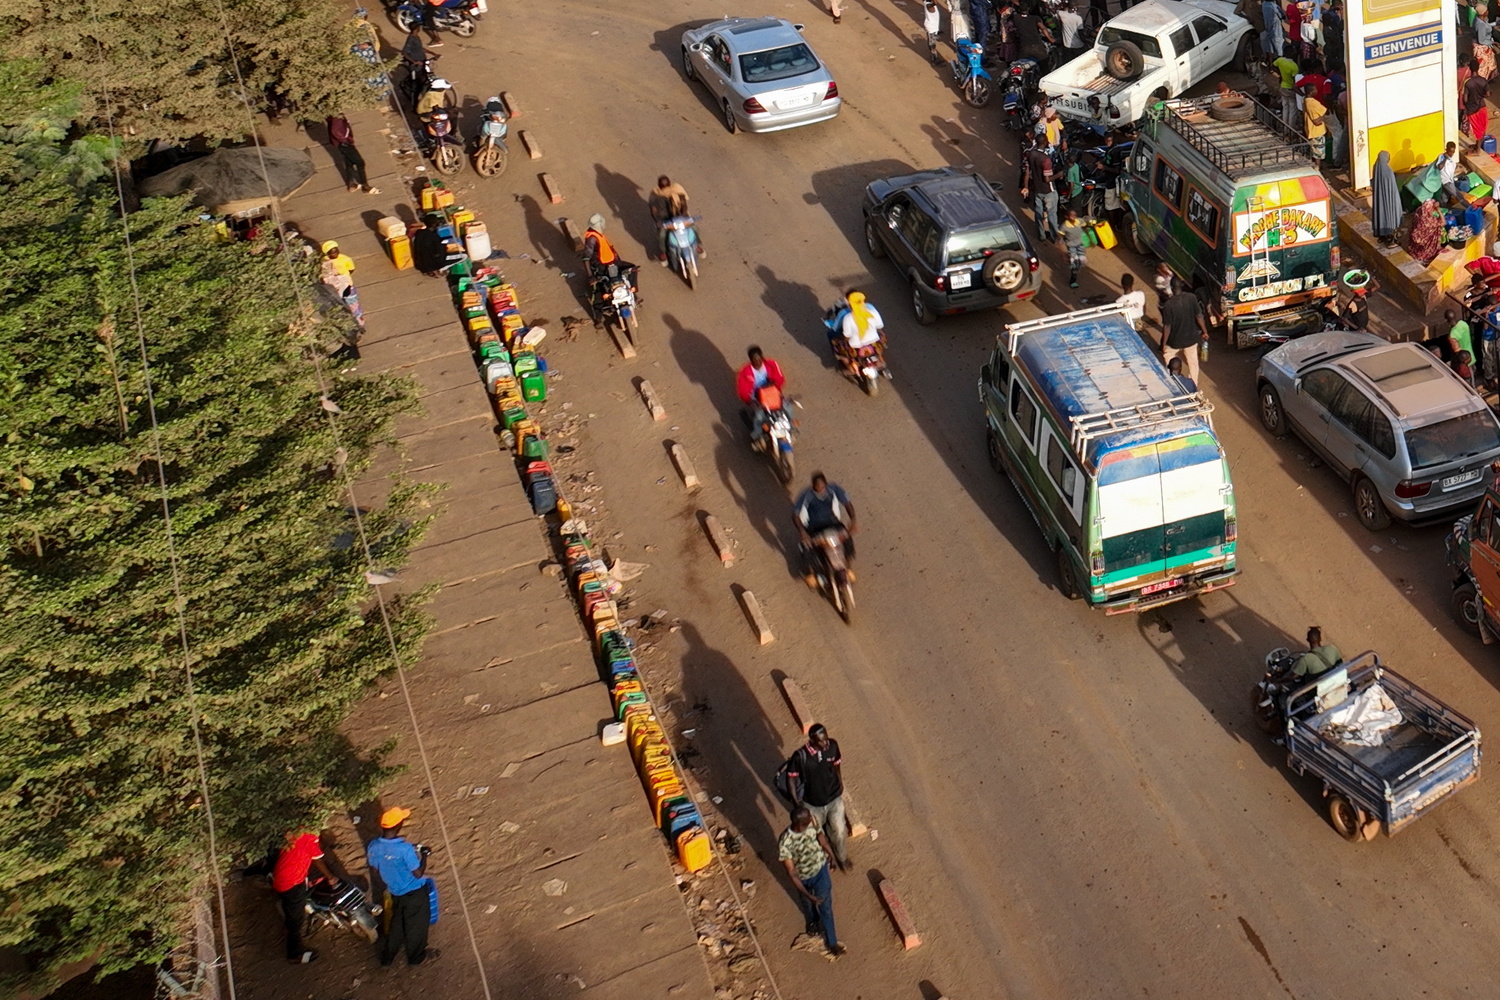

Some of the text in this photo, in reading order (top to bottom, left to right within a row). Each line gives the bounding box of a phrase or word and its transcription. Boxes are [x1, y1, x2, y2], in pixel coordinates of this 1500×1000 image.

[1370, 33, 1438, 58] BIENVENUE
[1281, 208, 1326, 238] BAKARY
[1239, 278, 1303, 302] CHAMPION
